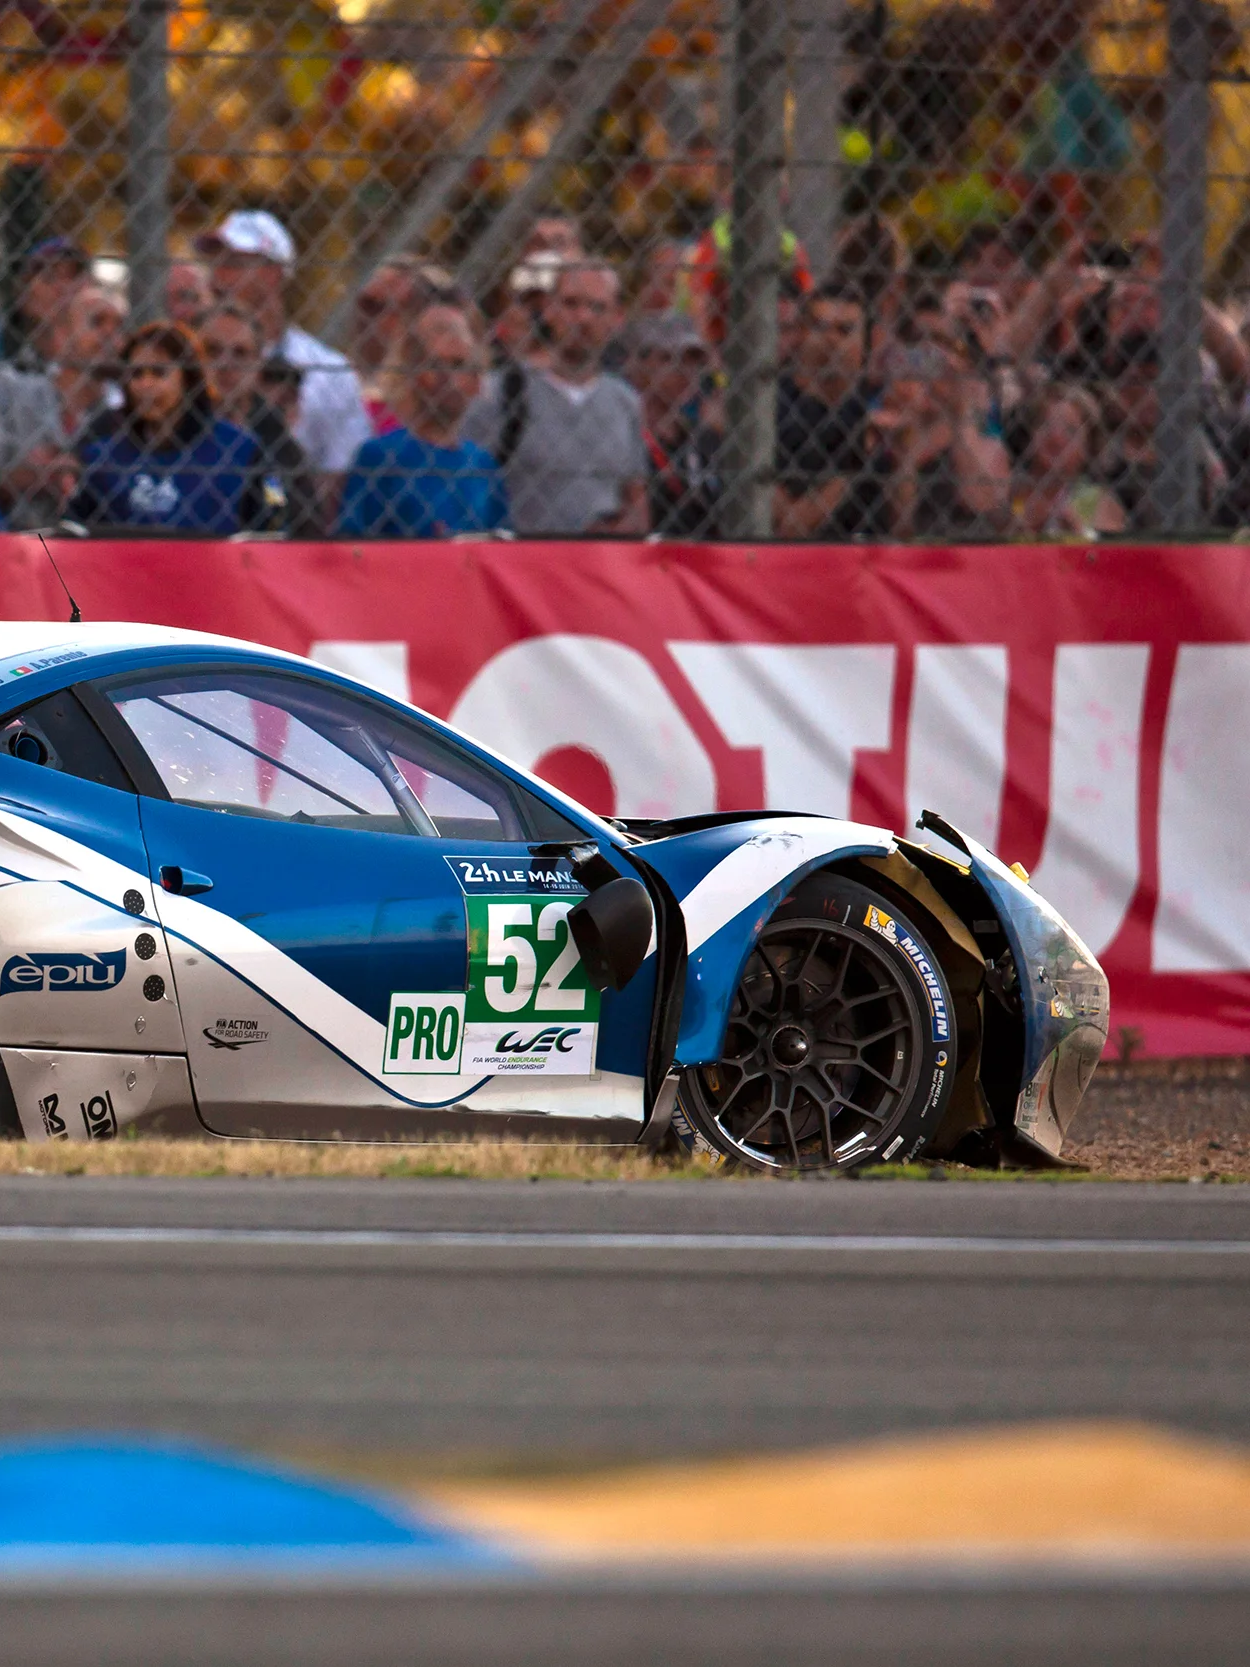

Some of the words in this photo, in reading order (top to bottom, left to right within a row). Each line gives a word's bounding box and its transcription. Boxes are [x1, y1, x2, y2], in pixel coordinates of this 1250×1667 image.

[29, 649, 88, 671] A.Parente
[459, 862, 501, 882] 24h
[502, 871, 527, 882] LE
[484, 902, 587, 1013] 52
[900, 937, 948, 1037] MICHELIN
[225, 1030, 243, 1038] ROAD
[244, 1031, 269, 1039] SAFETY
[228, 1020, 258, 1030] ACTION
[389, 1005, 460, 1061] PRO
[495, 1027, 582, 1053] WEC
[931, 1069, 945, 1108] MICHELIN
